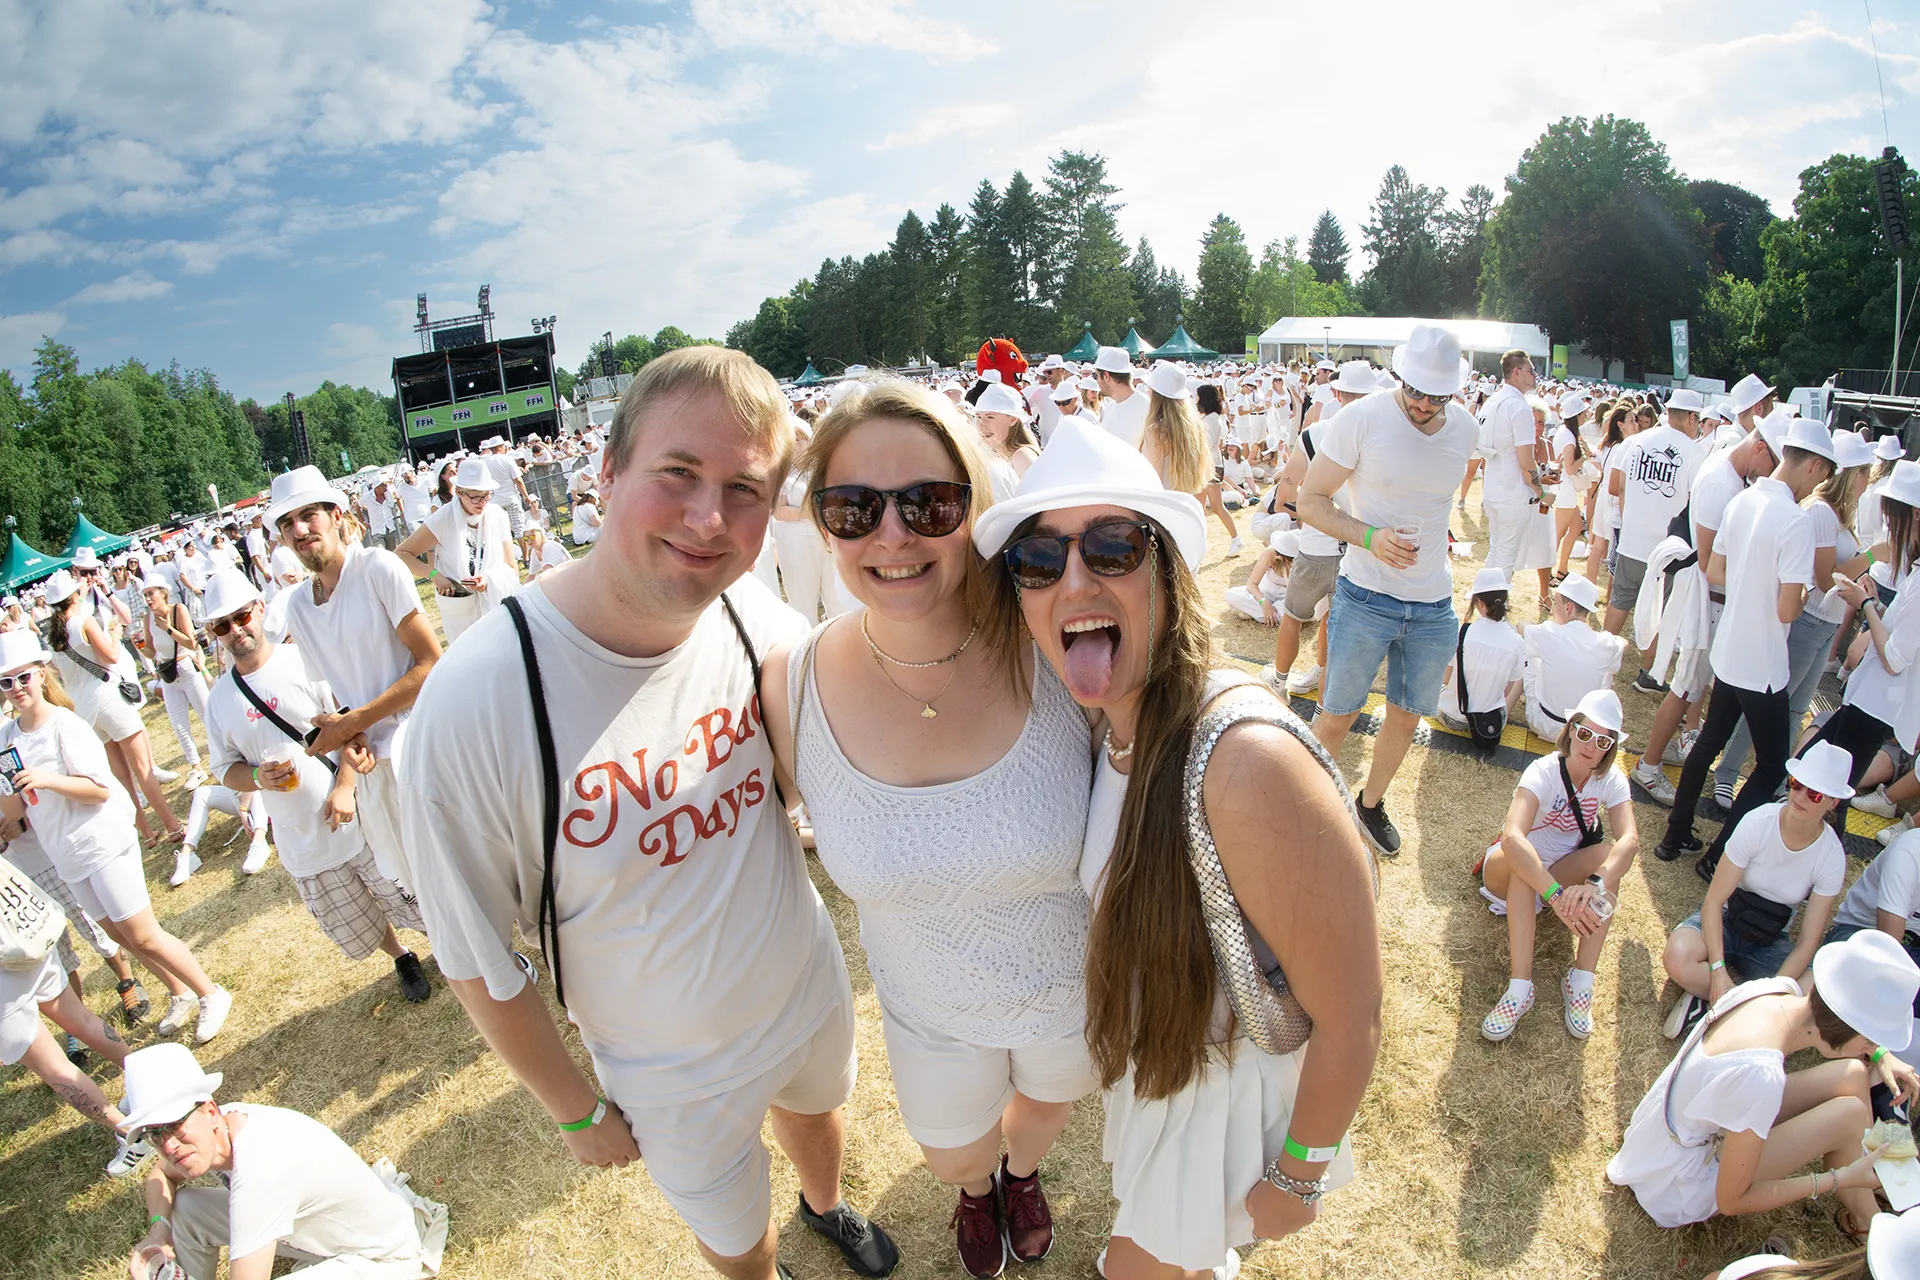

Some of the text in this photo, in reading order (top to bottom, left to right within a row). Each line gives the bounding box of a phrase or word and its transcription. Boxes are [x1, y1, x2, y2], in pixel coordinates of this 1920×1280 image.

[415, 396, 543, 428] FFH FFH FFH FFH
[563, 747, 678, 848] No
[639, 768, 765, 867] Days
